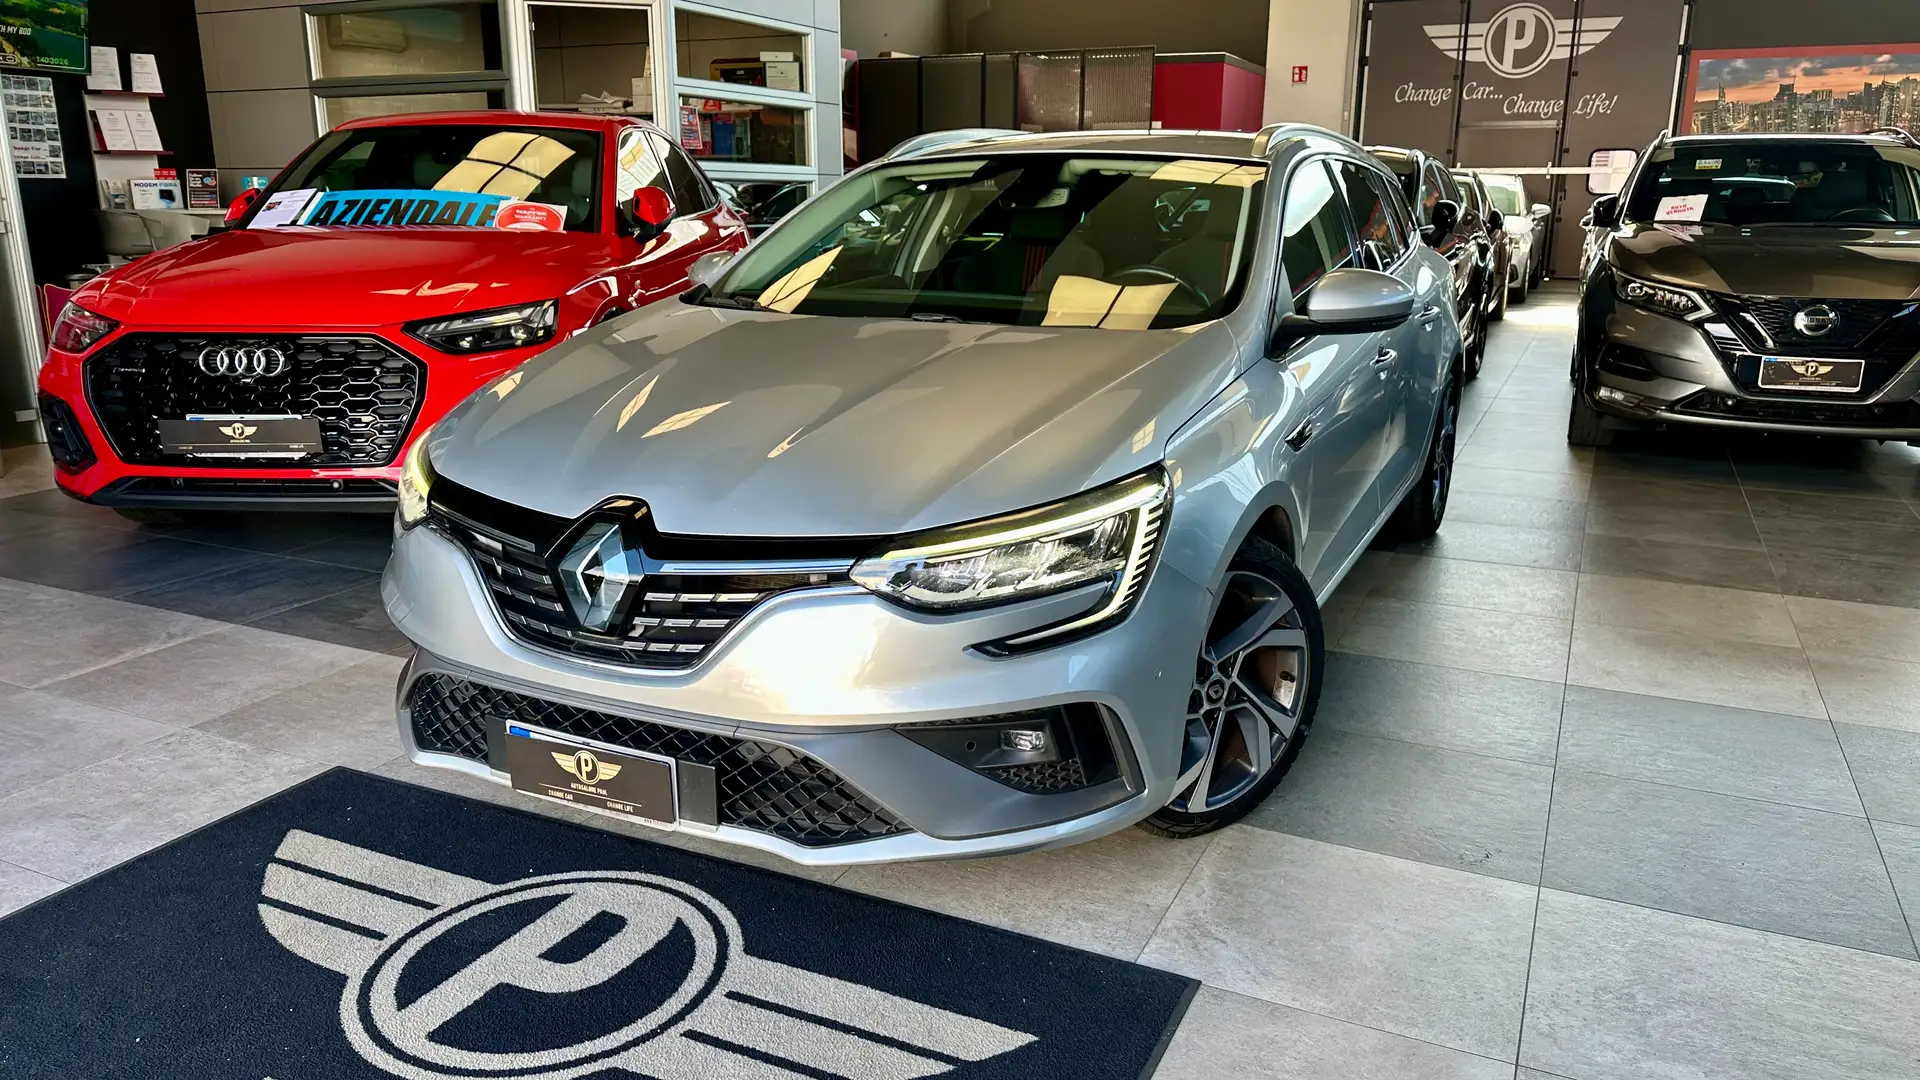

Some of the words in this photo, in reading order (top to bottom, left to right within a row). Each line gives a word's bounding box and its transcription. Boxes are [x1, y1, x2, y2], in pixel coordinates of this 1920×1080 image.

[7, 26, 18, 34] MY
[1394, 82, 1452, 107] Change
[1462, 81, 1504, 101] Car...
[1502, 93, 1564, 119] Change
[1572, 92, 1619, 119] Life!
[548, 789, 565, 799] CHANGE
[565, 792, 574, 801] CAR
[570, 782, 597, 794] AUTOSALONE
[597, 787, 608, 796] PAUL
[606, 800, 624, 811] CHANGE
[624, 804, 634, 813] LIFE
